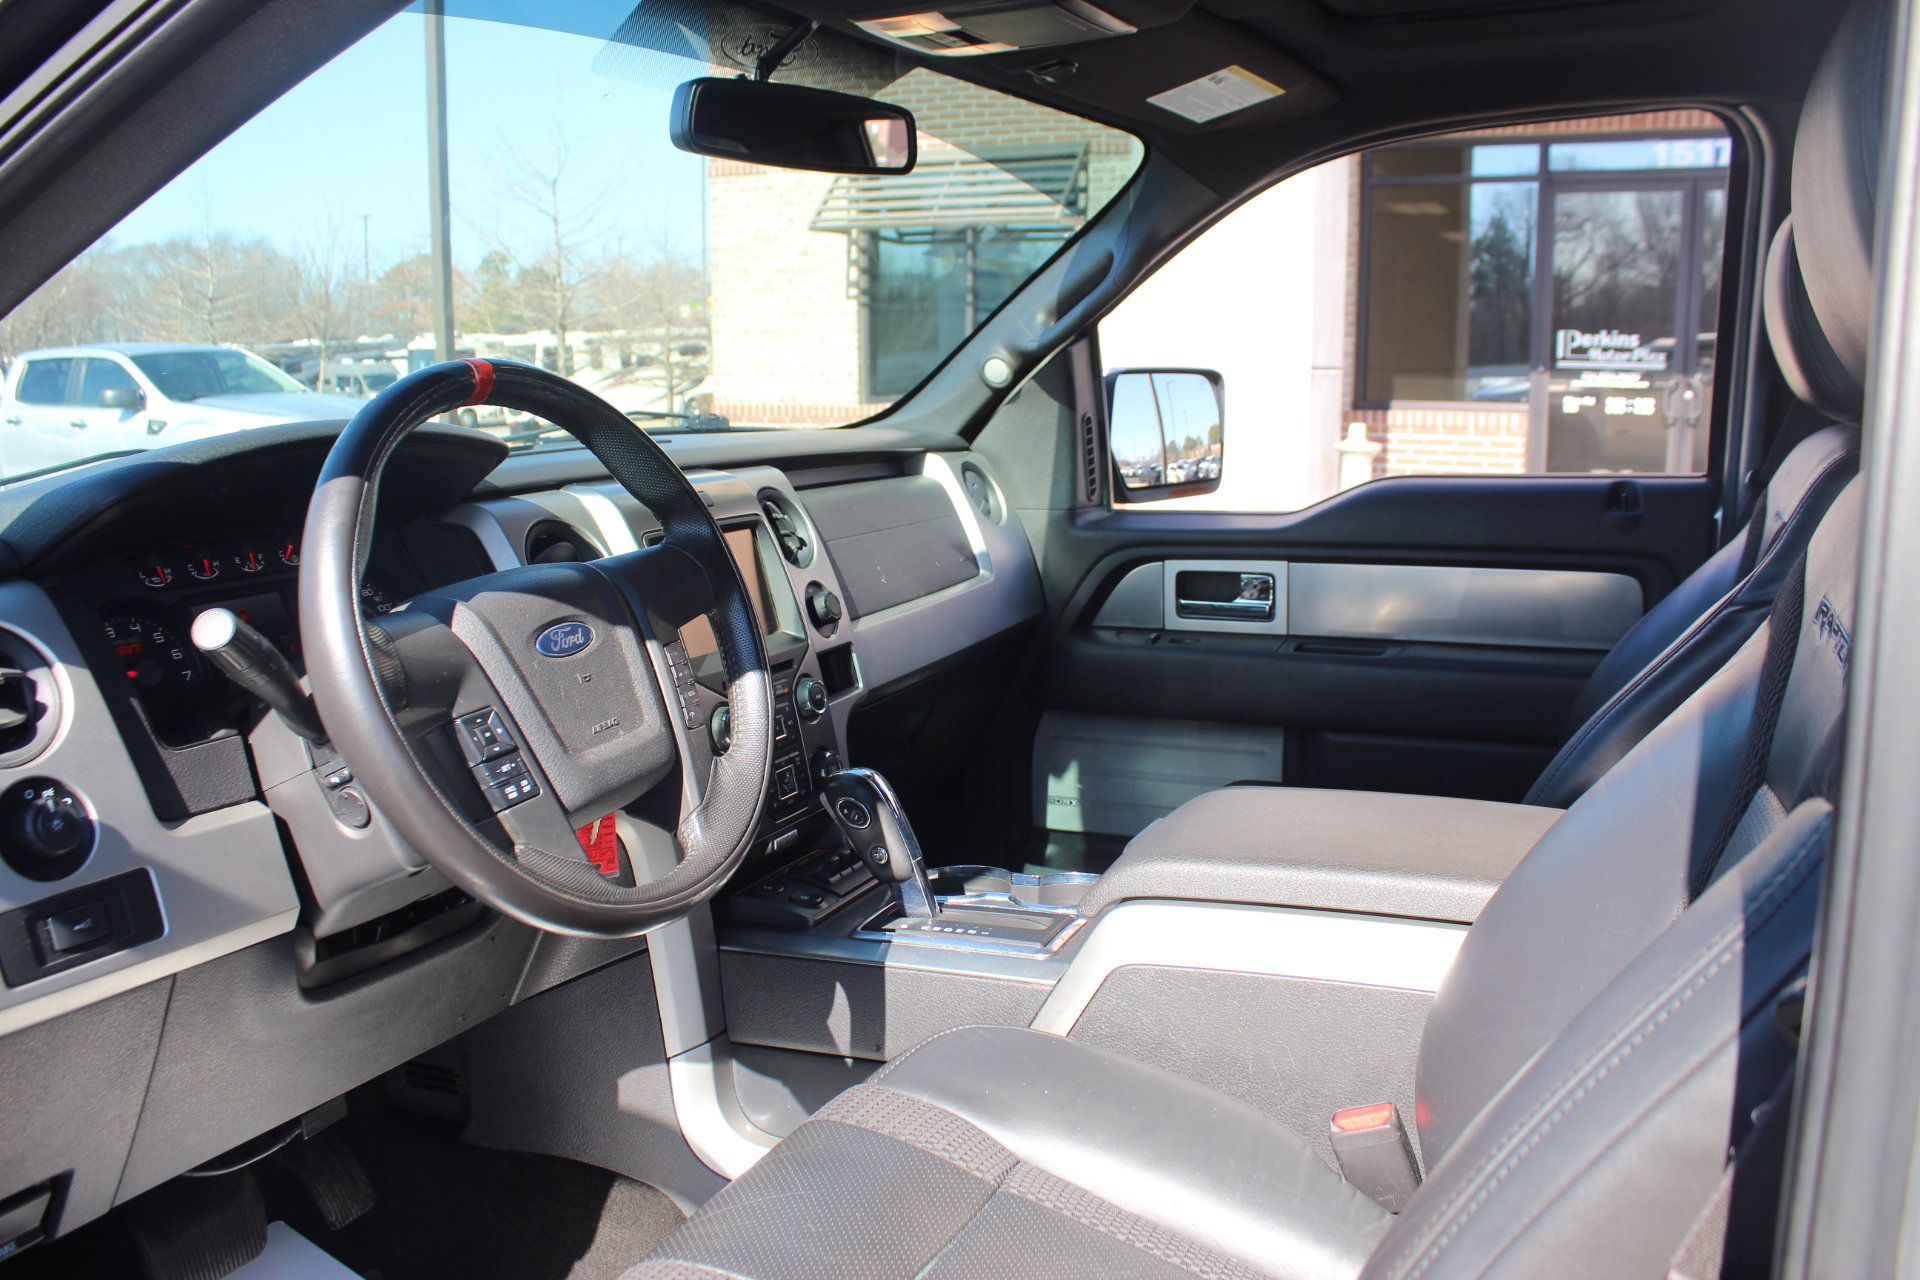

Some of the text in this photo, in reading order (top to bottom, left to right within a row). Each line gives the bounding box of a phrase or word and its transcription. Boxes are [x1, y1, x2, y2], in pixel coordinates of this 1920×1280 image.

[1652, 138, 1732, 169] 1517
[1556, 329, 1641, 359] Perkins
[104, 627, 116, 639] 3
[130, 623, 142, 633] 4
[152, 631, 165, 644] 5
[550, 626, 584, 652] Ford
[170, 648, 183, 660] 6
[180, 670, 192, 681] 7
